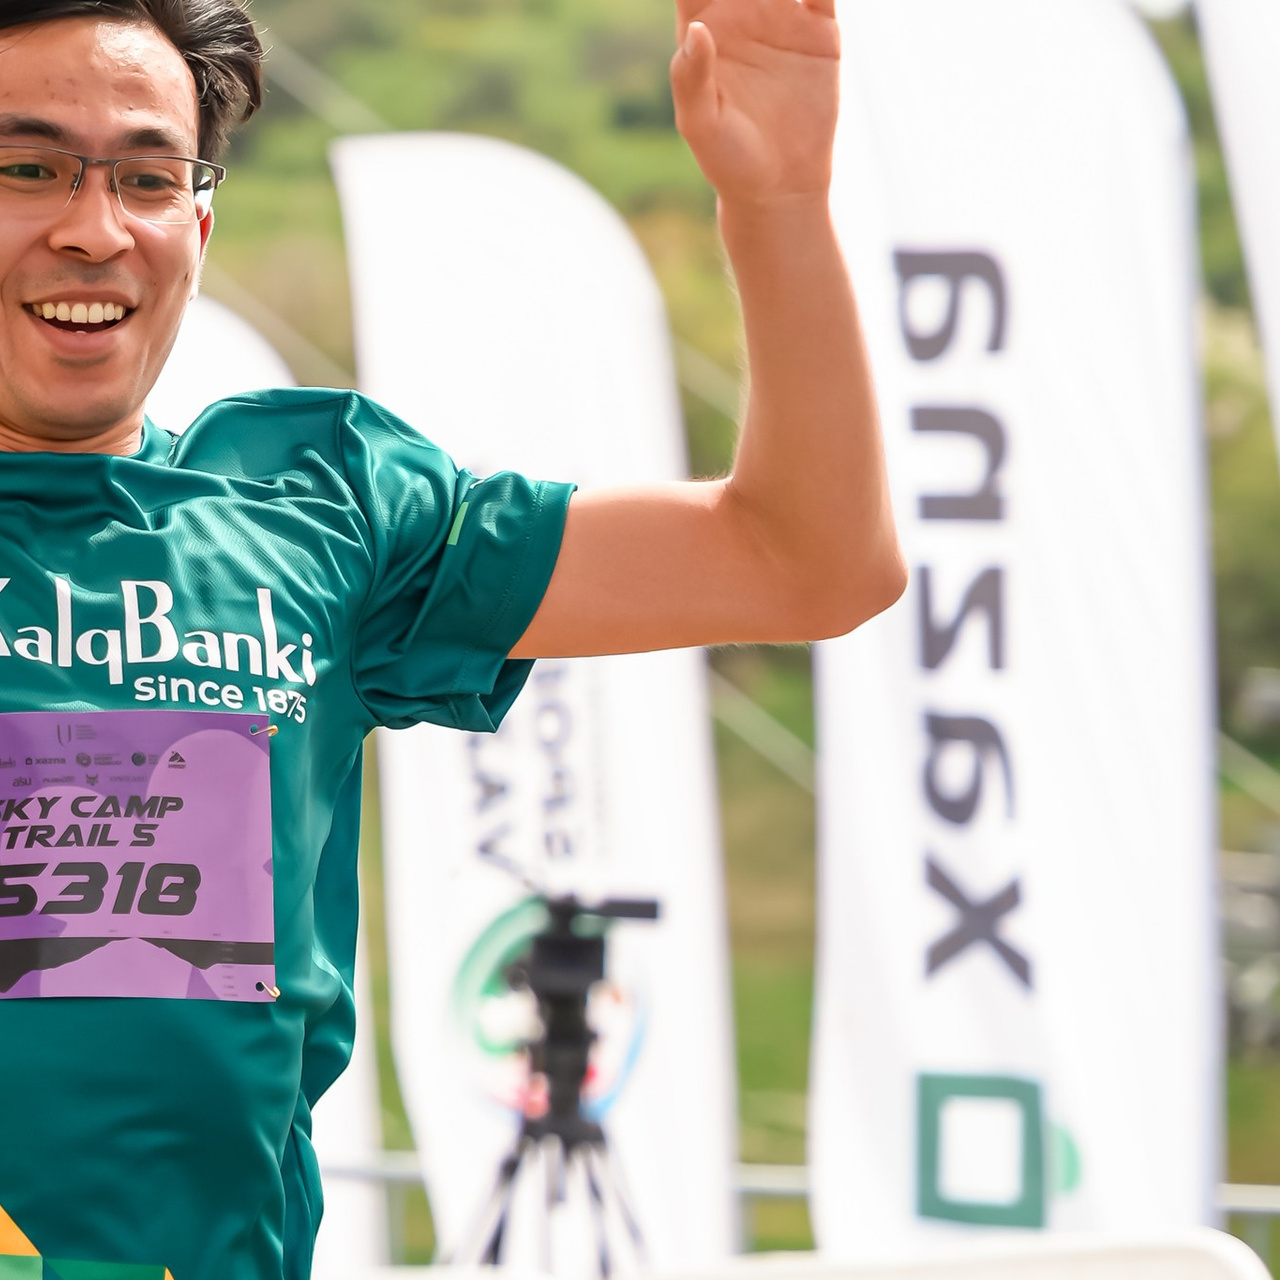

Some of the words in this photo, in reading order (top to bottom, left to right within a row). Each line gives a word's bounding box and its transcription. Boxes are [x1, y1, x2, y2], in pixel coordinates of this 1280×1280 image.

[133, 675, 244, 711] since
[252, 685, 308, 724] 1875
[70, 795, 184, 820] CAMP
[3, 824, 121, 851] TRAIL
